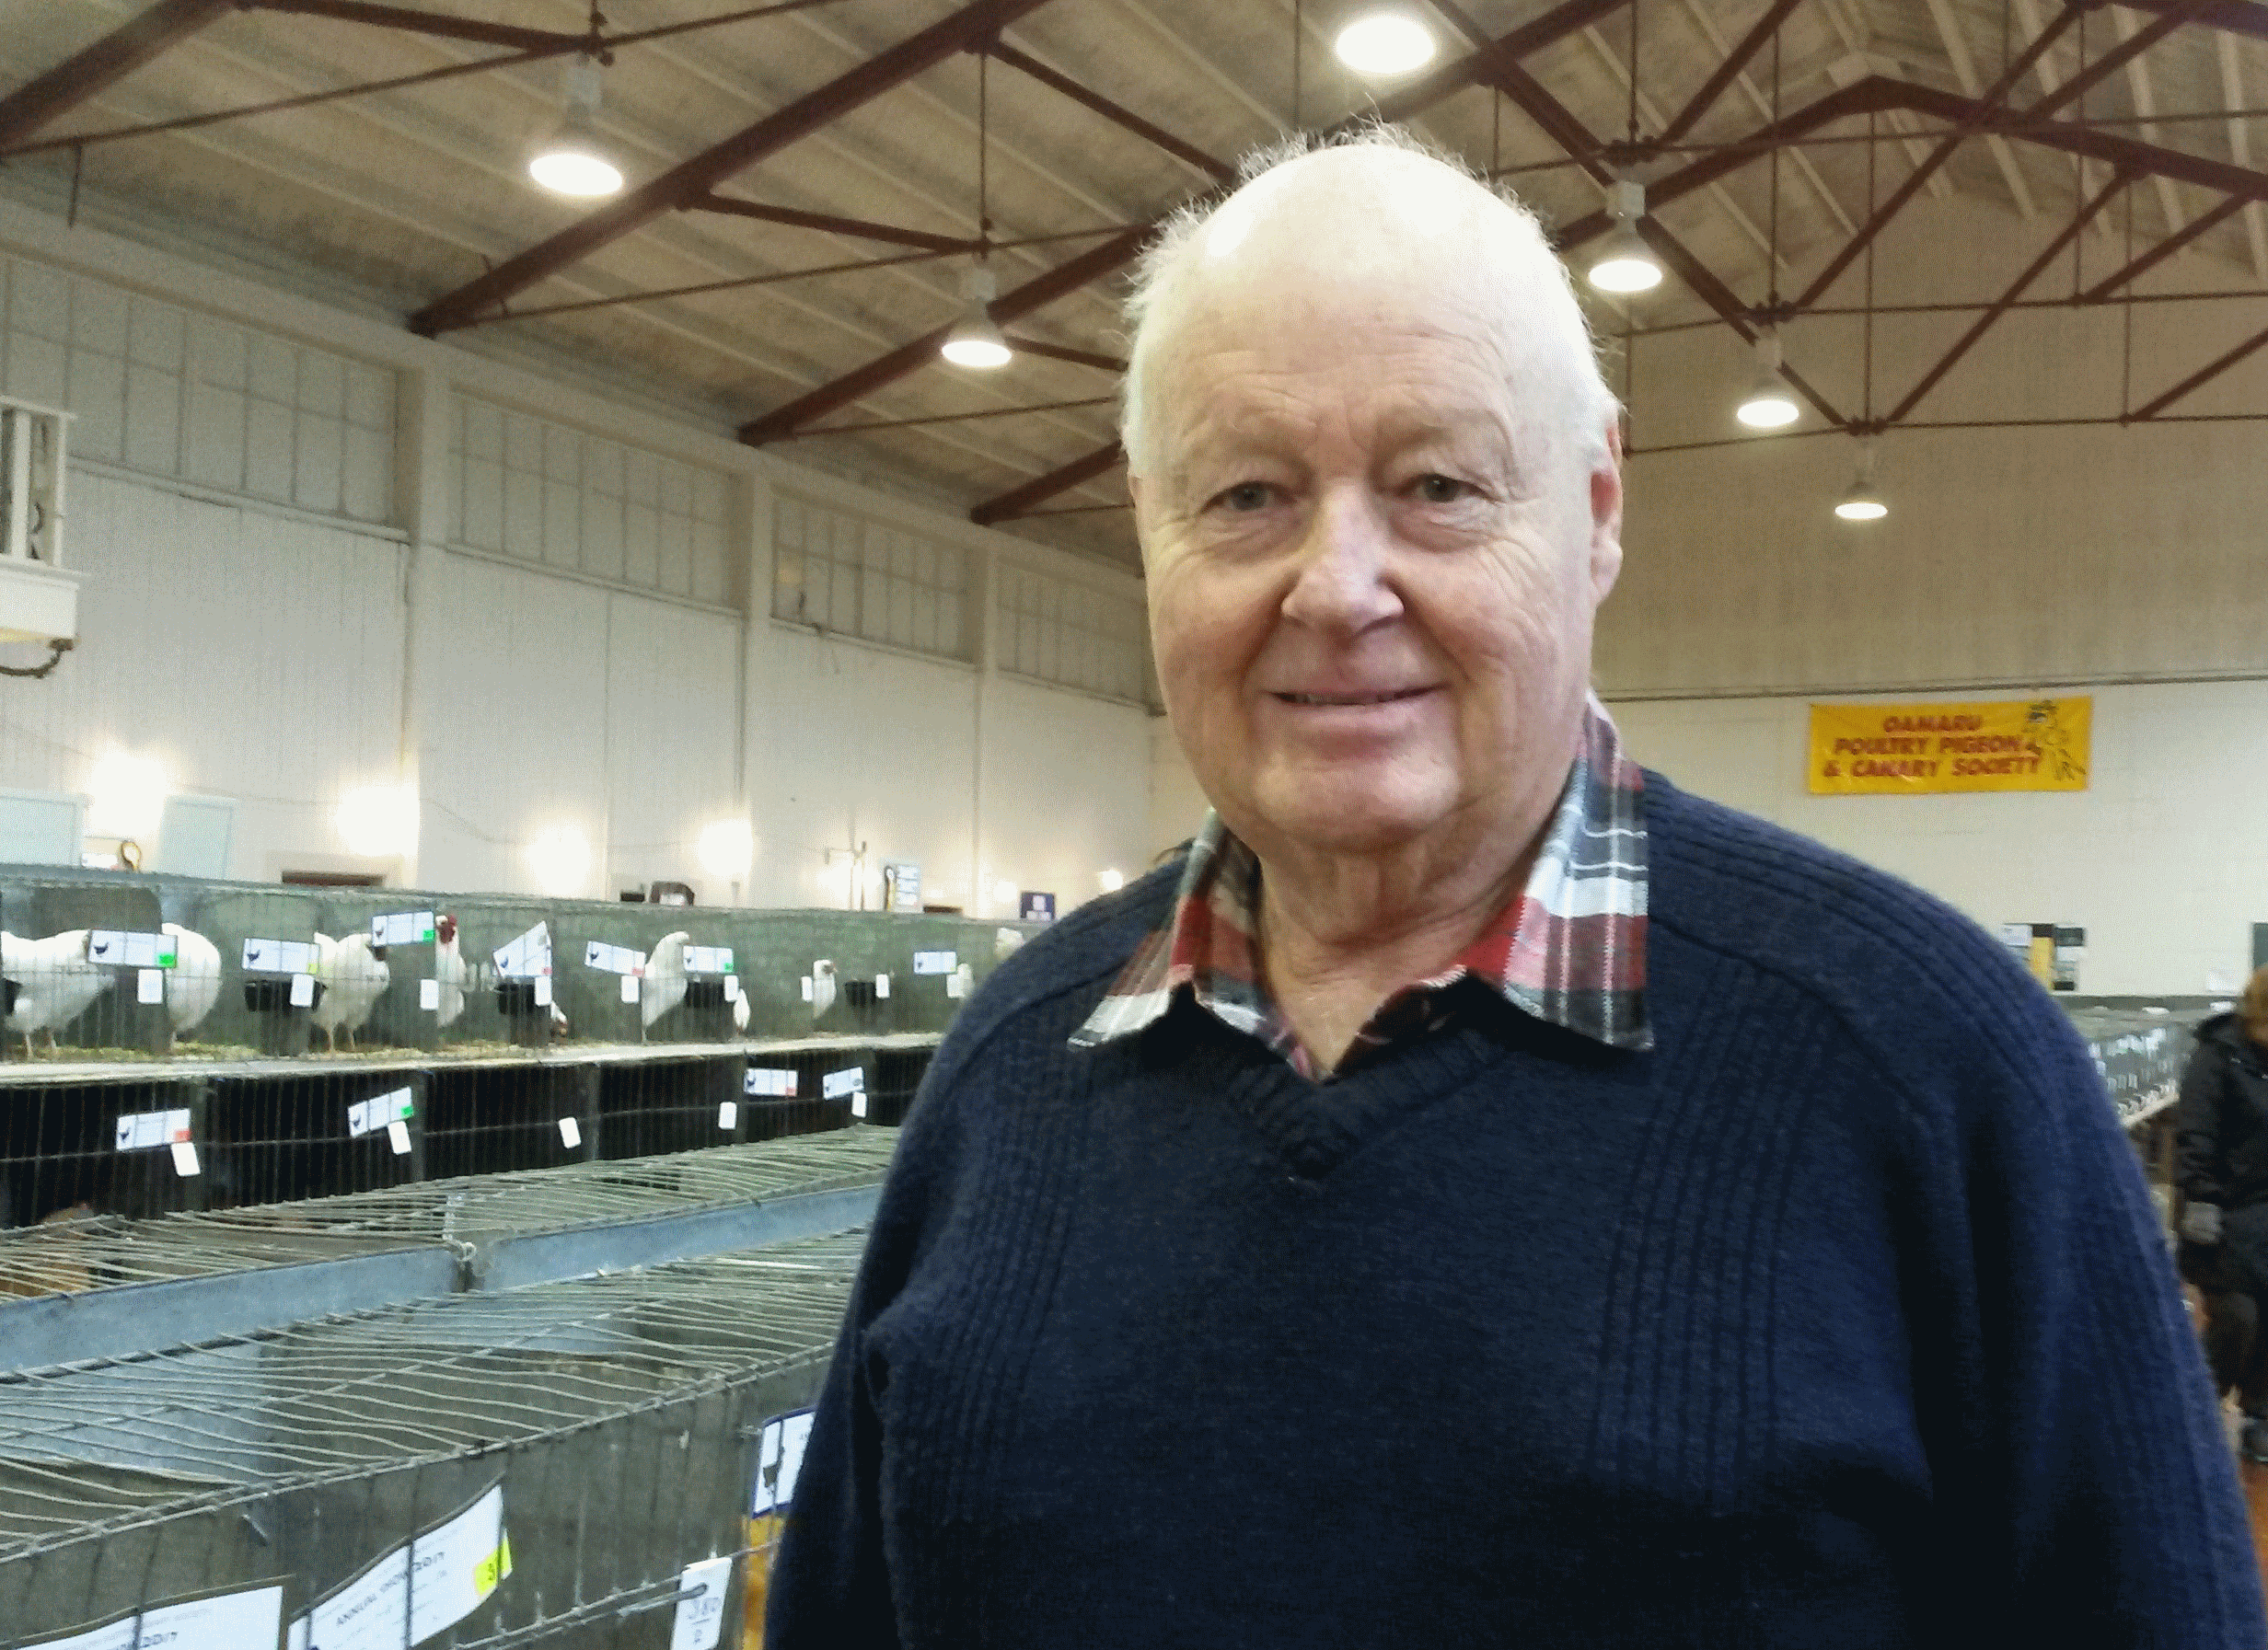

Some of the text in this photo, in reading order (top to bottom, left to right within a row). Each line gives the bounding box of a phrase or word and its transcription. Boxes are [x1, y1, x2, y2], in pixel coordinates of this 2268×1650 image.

[1834, 736, 1929, 756] POULTRY
[1822, 756, 2041, 778] & CANARY SOCIETY
